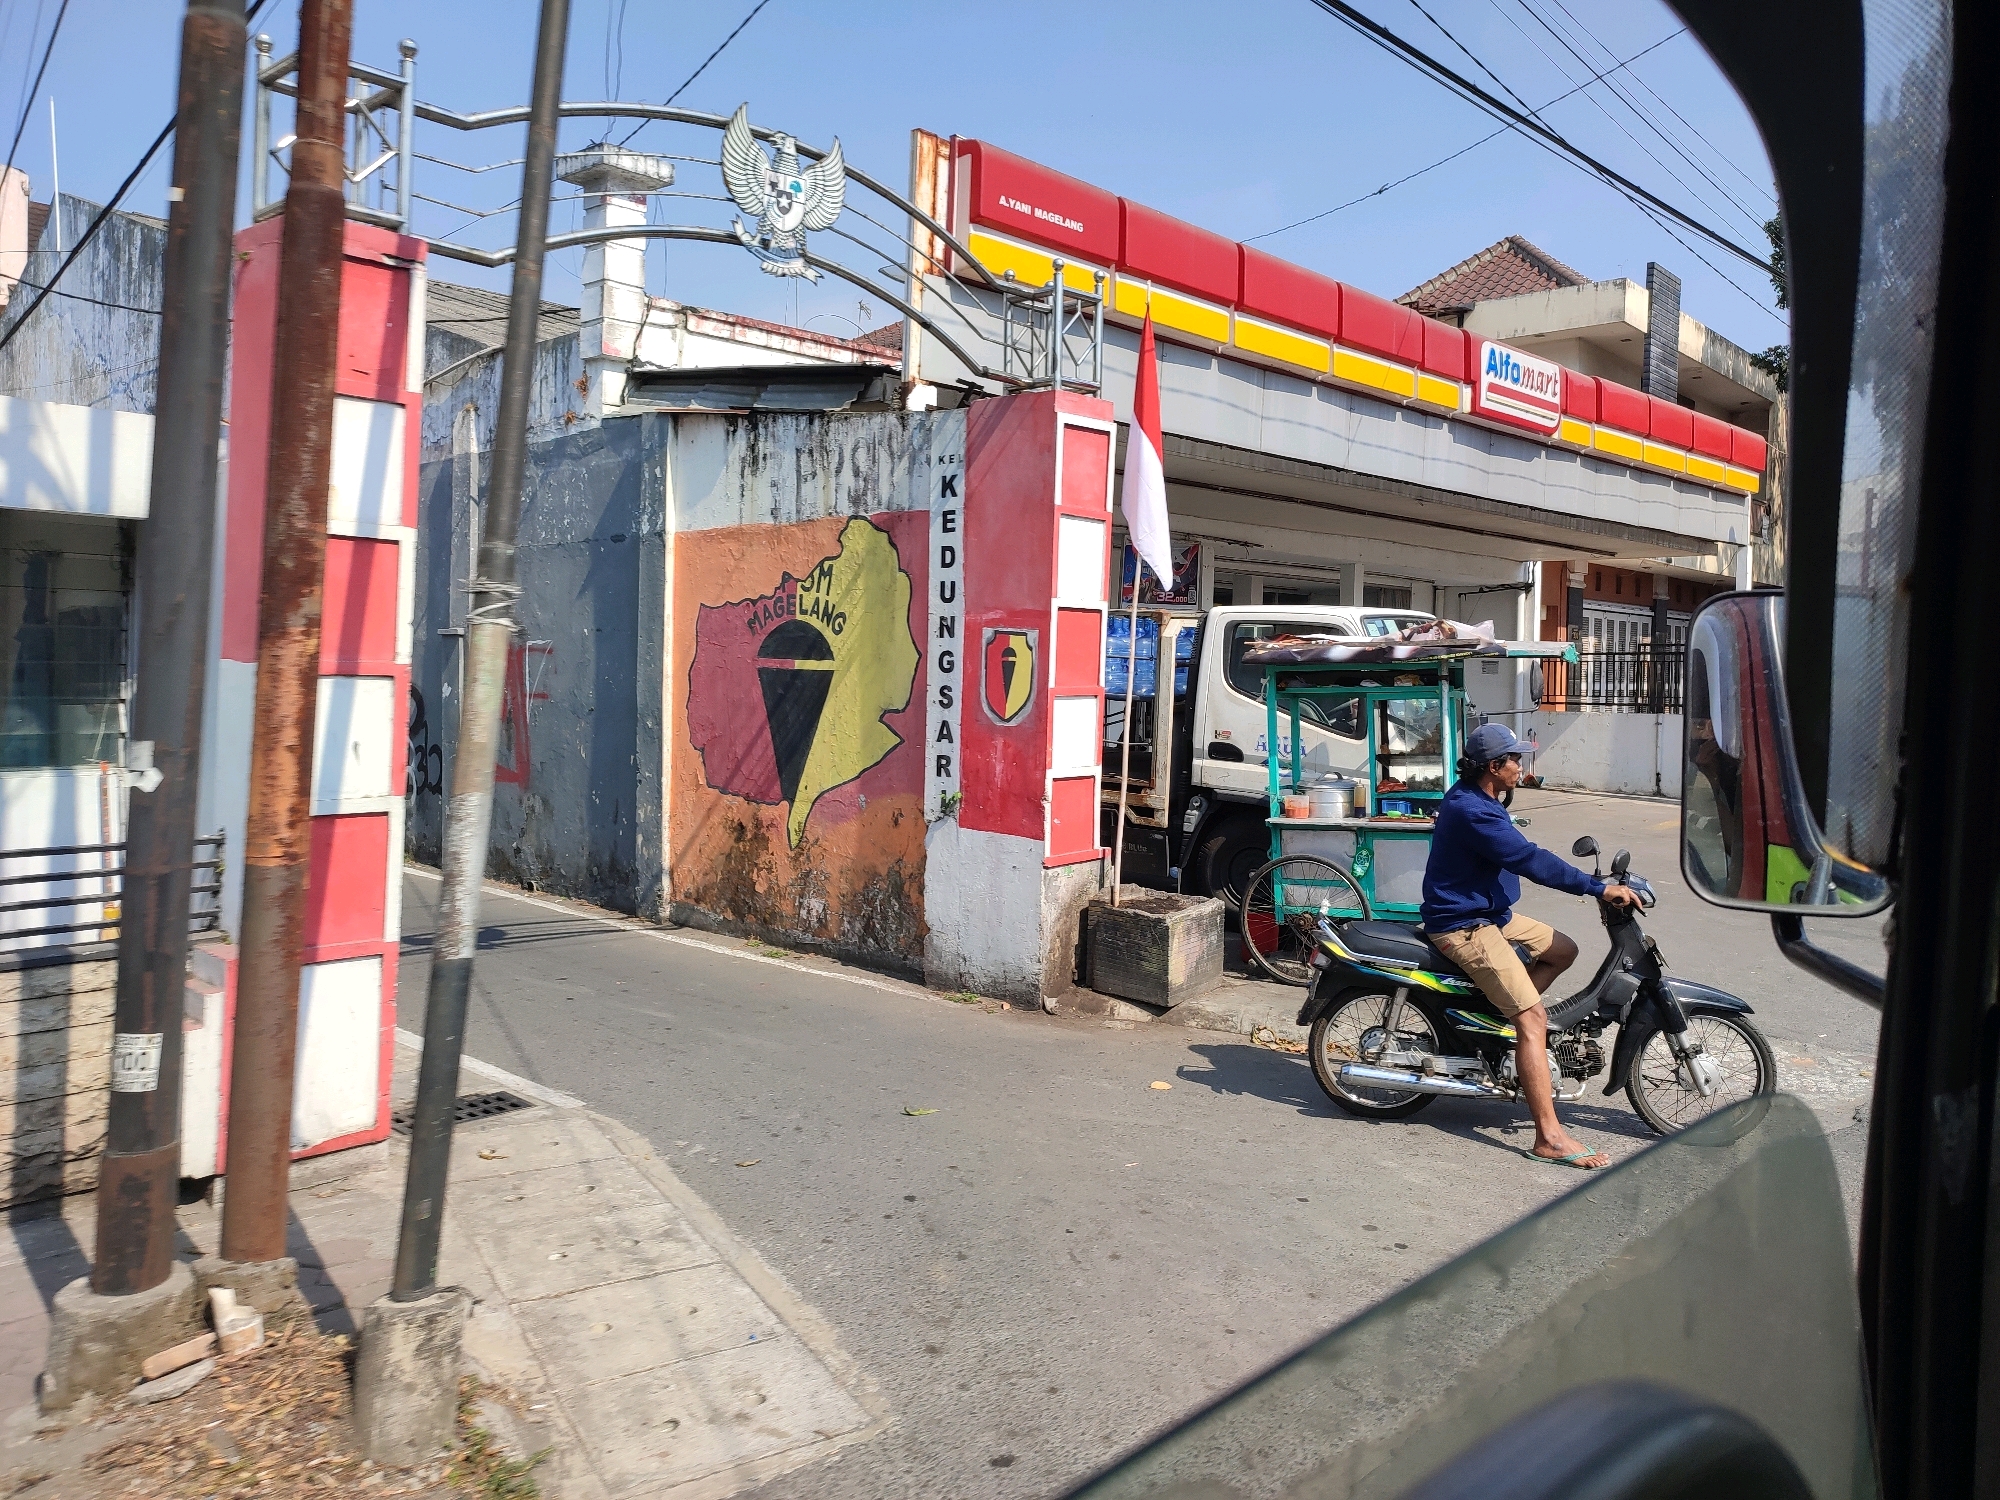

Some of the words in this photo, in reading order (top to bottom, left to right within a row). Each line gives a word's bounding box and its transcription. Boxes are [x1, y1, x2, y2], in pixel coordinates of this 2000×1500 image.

[999, 195, 1032, 215] A.YANI
[1034, 207, 1084, 233] MAGELANG
[1486, 347, 1558, 398] Alfamart
[747, 594, 847, 636] MAGELANG
